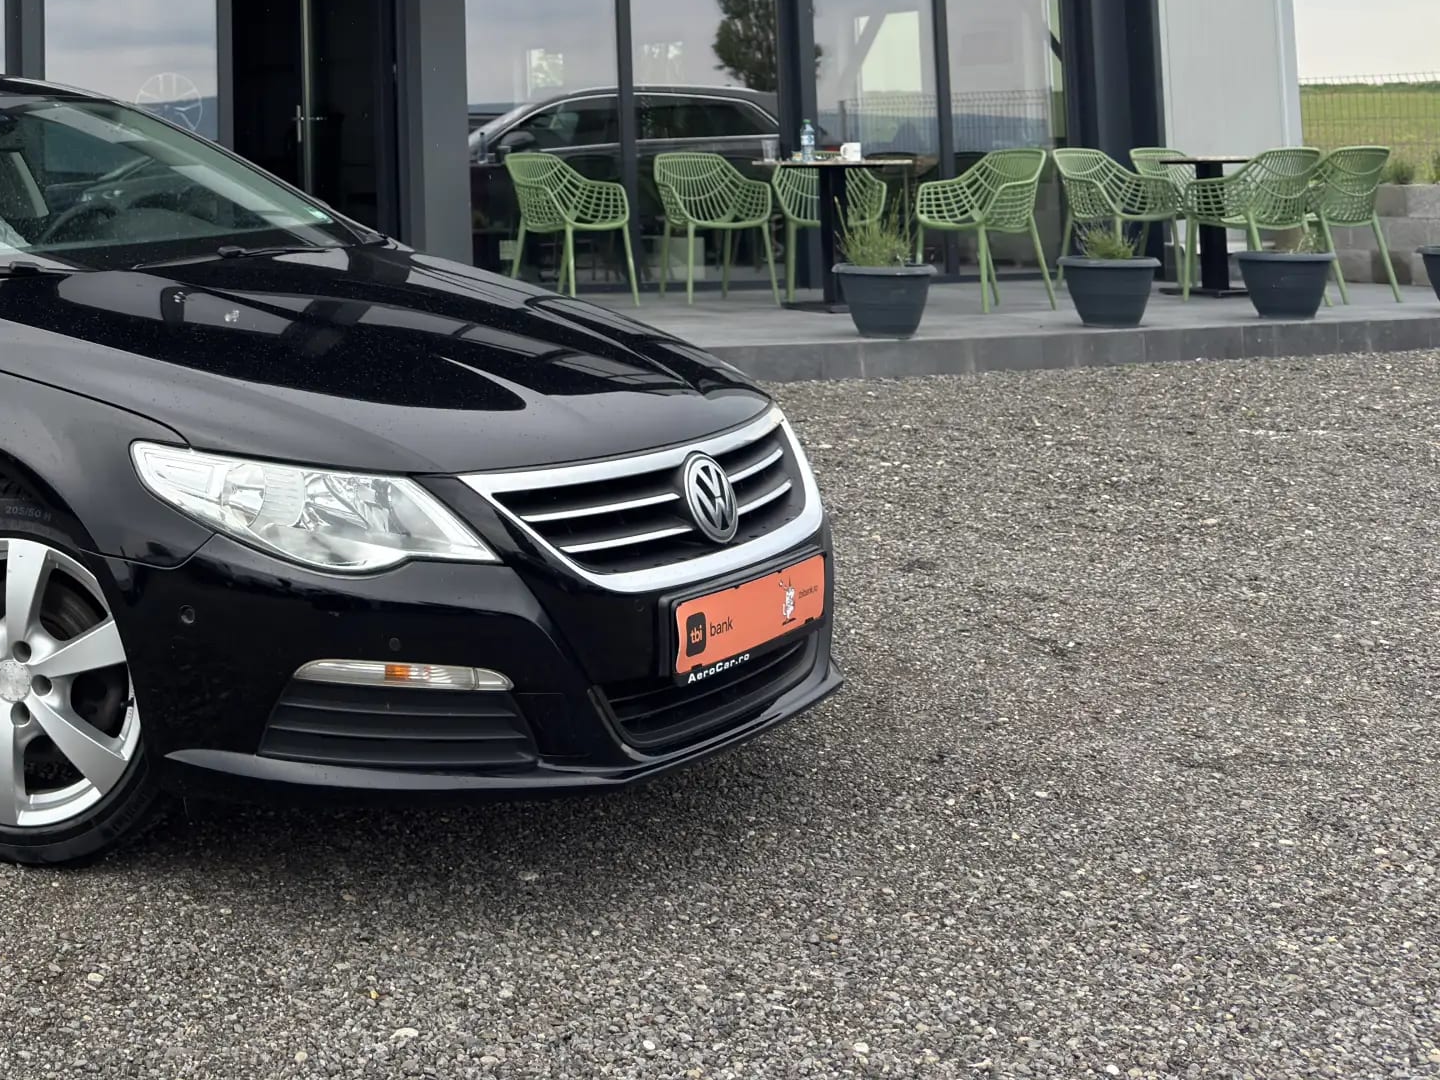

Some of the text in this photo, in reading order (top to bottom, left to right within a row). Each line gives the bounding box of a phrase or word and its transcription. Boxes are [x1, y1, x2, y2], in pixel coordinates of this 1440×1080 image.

[690, 616, 733, 644] tbi bank
[687, 653, 750, 684] AeroCar.ro
